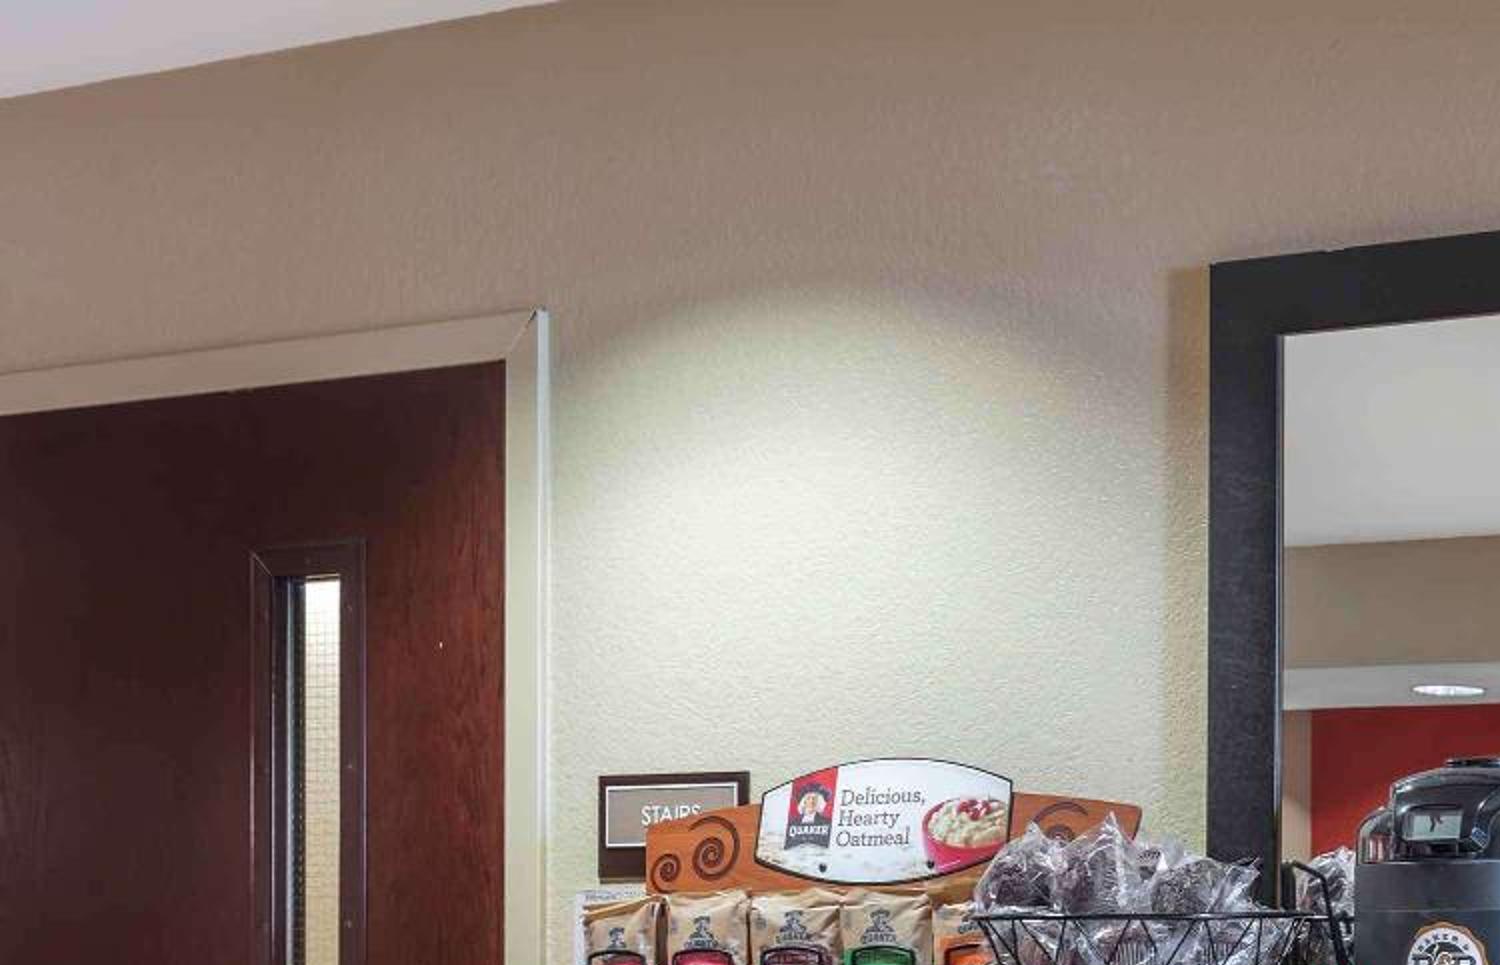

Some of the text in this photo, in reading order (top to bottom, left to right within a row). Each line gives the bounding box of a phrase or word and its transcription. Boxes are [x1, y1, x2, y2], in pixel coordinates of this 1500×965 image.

[839, 786, 926, 808] Delicious,
[837, 809, 900, 830] Hearty
[835, 826, 910, 848] Oatmeal
